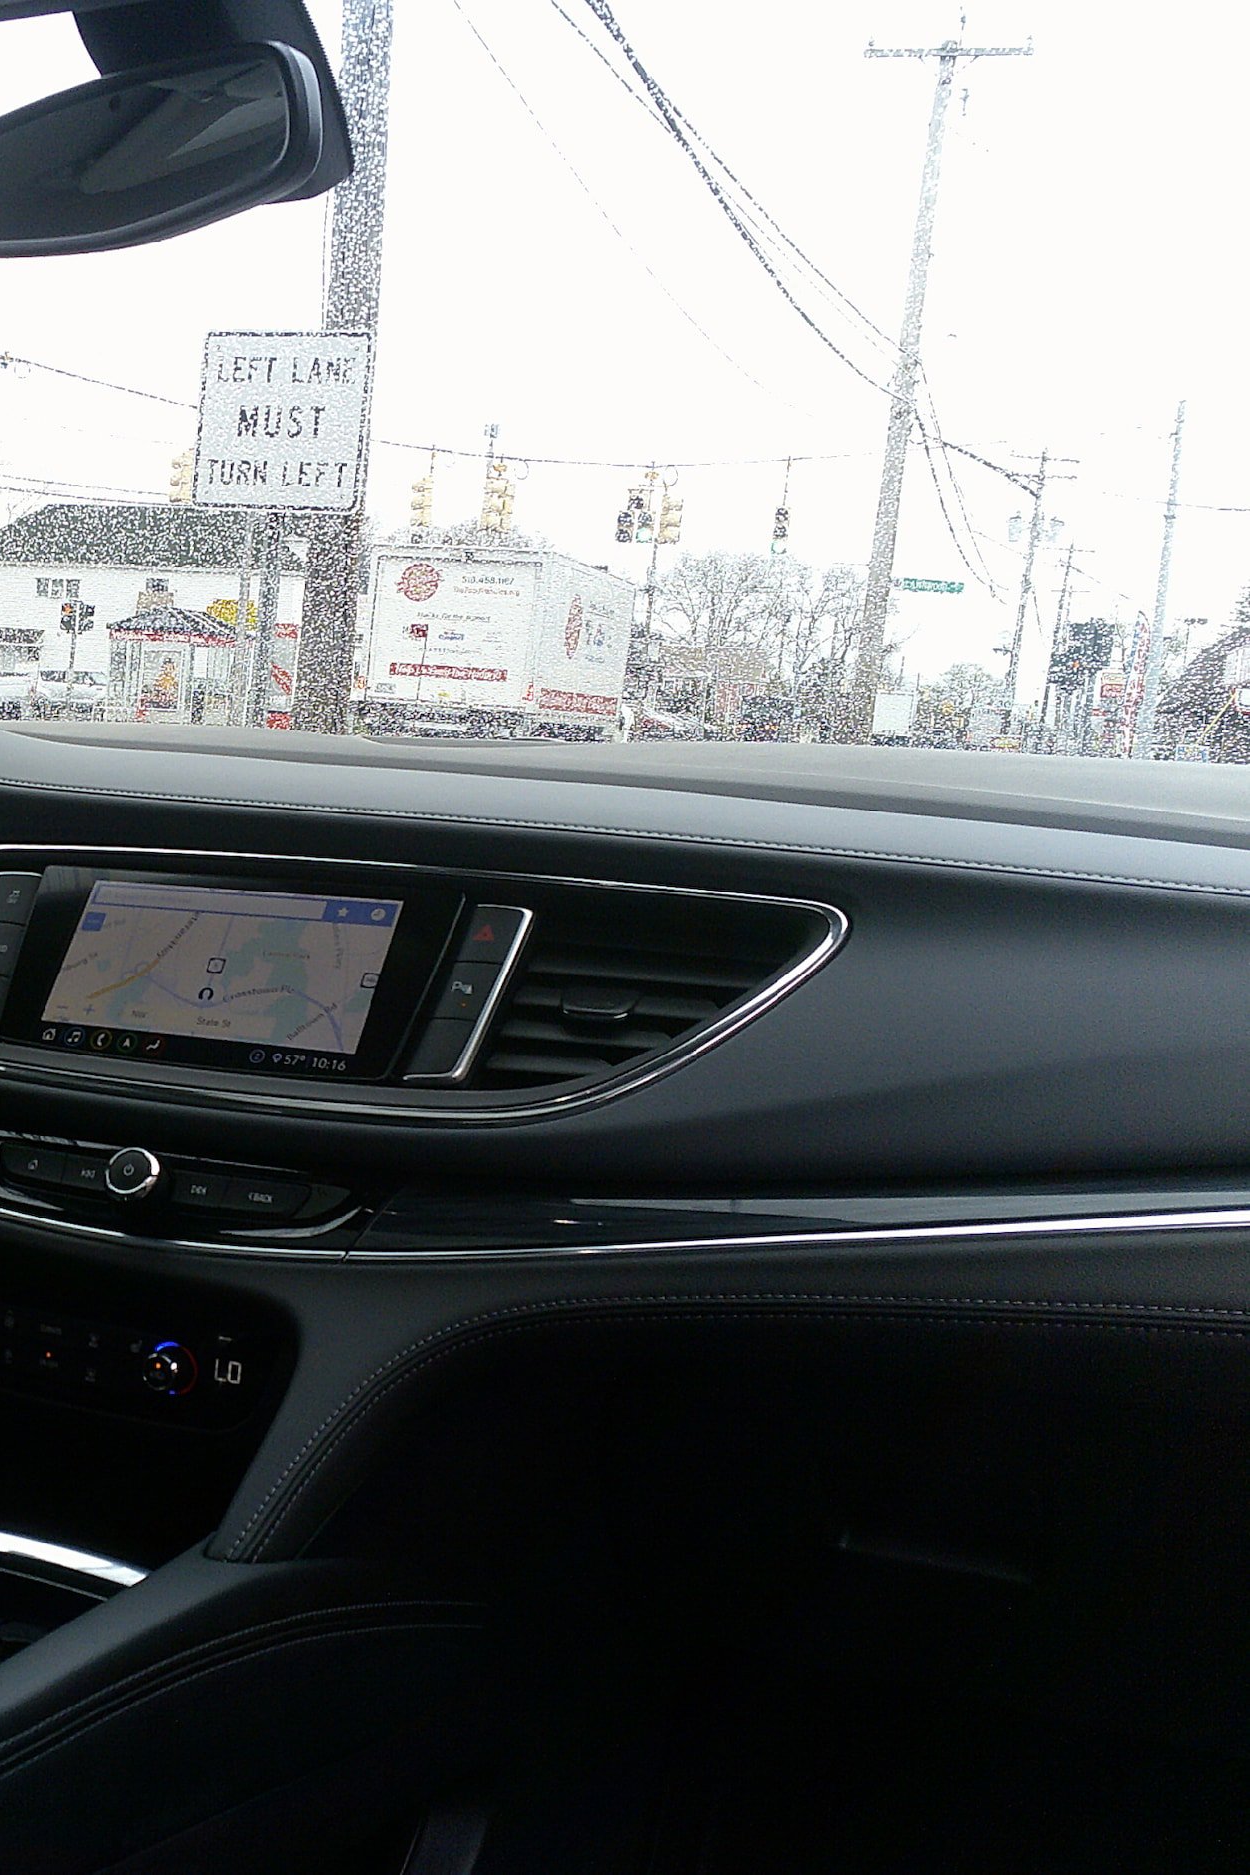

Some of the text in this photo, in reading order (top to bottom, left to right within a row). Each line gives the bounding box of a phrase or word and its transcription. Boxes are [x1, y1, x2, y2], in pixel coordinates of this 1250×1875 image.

[216, 356, 357, 385] LEFT LANE
[236, 404, 326, 439] MUST
[206, 458, 348, 488] TURN LEFT
[196, 1016, 219, 1028] State
[311, 1057, 347, 1072] 10:16
[214, 1360, 243, 1386] LO
